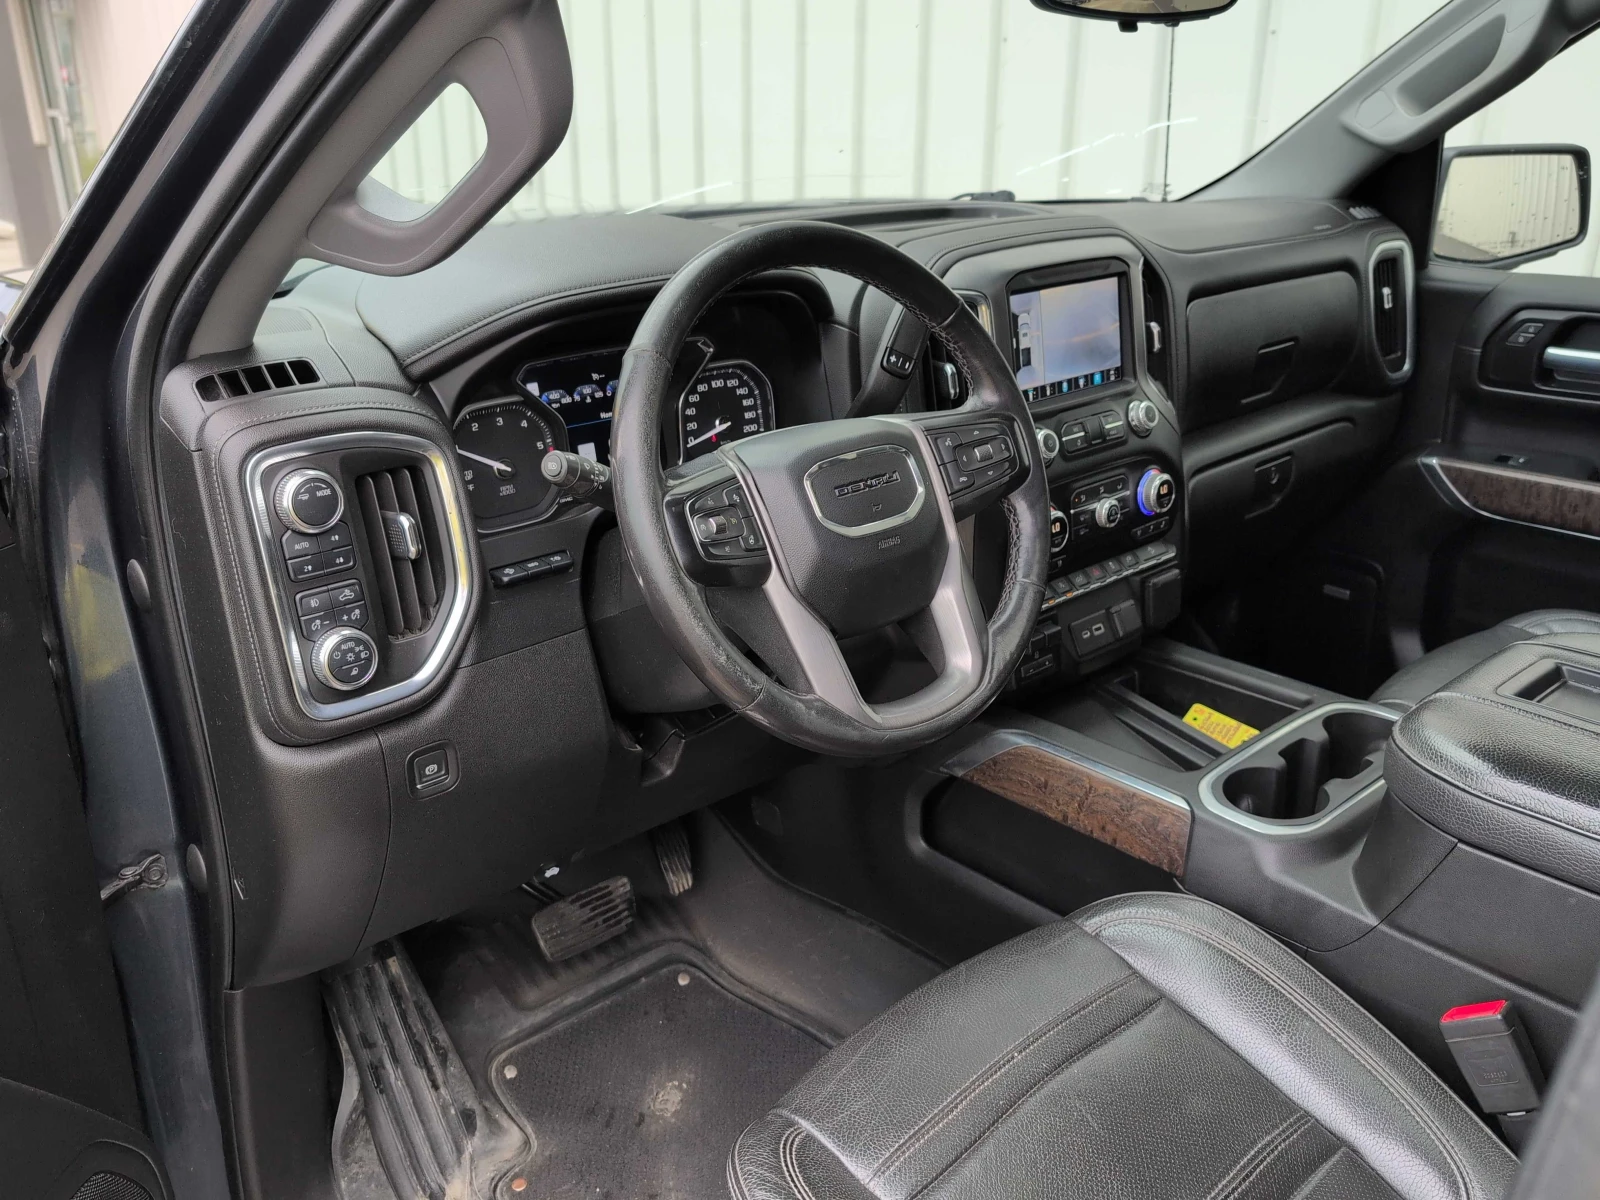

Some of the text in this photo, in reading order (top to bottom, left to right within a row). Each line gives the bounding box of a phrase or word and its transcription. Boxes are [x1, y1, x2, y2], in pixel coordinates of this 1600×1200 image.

[711, 379, 724, 388] 100
[726, 378, 739, 388] 120
[697, 383, 708, 393] 80
[736, 387, 748, 396] 140
[688, 394, 700, 403] 60
[742, 398, 755, 407] 160
[685, 407, 696, 415] 40
[496, 417, 504, 426] 3
[520, 420, 528, 428] 4
[471, 422, 479, 432] 2
[686, 422, 698, 431] 20
[743, 423, 758, 433] 200
[536, 441, 544, 450] 5
[316, 488, 332, 498] MODE
[294, 541, 310, 550] AUTO
[341, 641, 356, 650] AUTO
